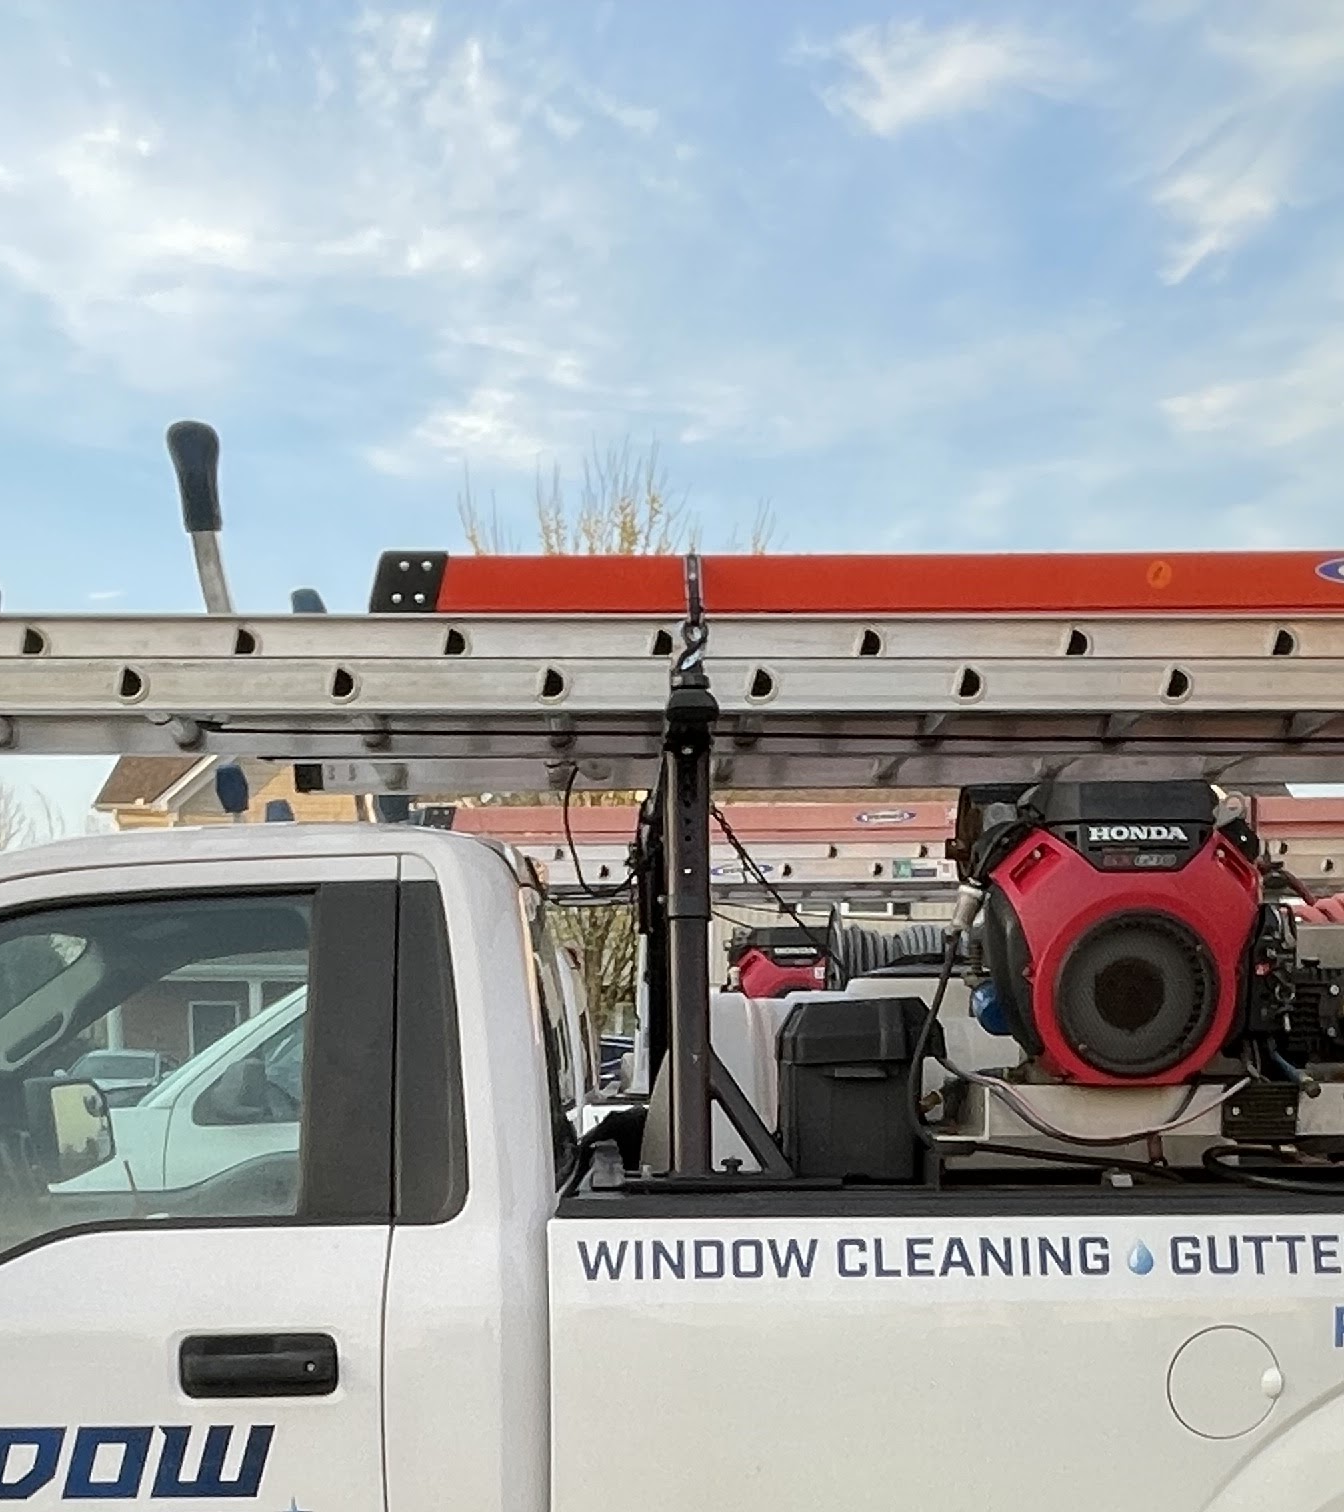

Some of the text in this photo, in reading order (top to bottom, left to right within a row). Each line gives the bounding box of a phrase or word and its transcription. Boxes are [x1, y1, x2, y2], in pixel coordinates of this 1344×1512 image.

[1088, 826, 1189, 841] HONDA
[576, 1238, 818, 1281] WINDOW
[836, 1236, 1112, 1278] CLEANING
